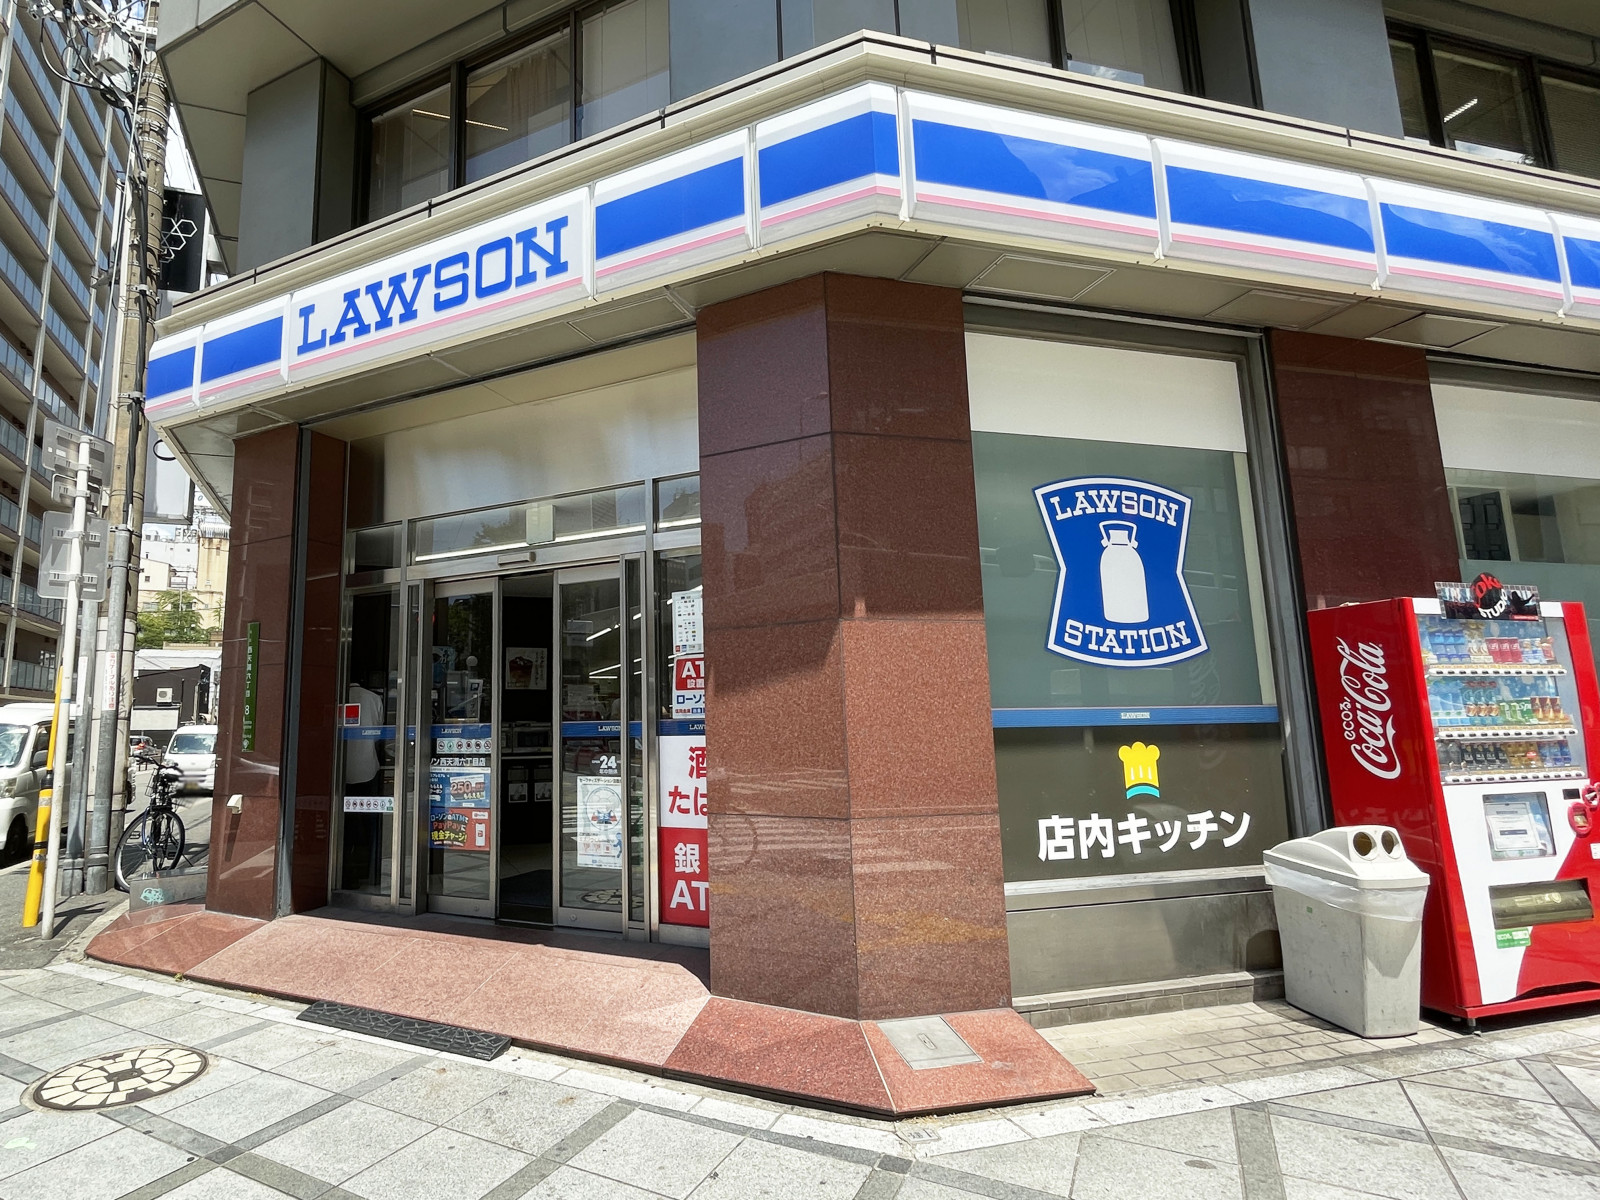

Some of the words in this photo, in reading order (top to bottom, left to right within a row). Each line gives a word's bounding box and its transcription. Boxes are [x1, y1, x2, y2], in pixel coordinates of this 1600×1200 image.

[297, 215, 569, 355] LAWSON
[1050, 488, 1179, 527] LAWSON
[1063, 618, 1191, 655] STATION
[676, 694, 705, 704] ローソ
[1120, 712, 1151, 720] LAWSON
[1335, 636, 1402, 780] Coca-Cola
[599, 755, 617, 769] 24
[450, 781, 472, 794] 250
[1038, 811, 1251, 862] 店内キッチン
[674, 842, 701, 874] 銀
